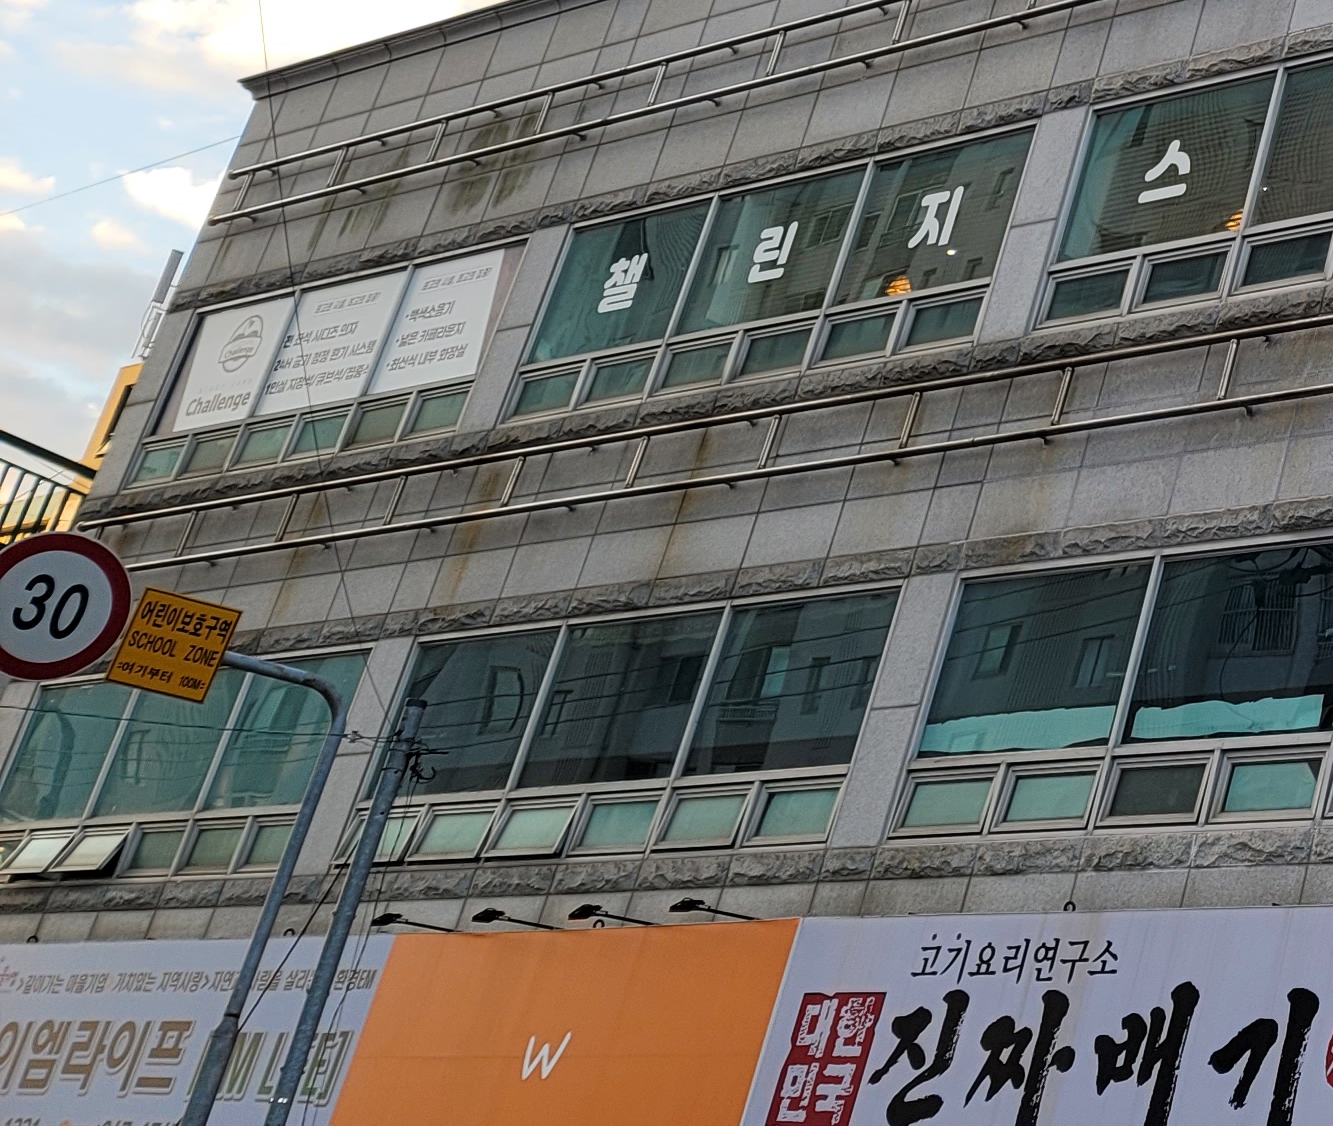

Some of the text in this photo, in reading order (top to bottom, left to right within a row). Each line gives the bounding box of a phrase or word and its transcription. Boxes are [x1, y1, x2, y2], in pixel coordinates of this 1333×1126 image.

[185, 391, 251, 417] Challenge
[12, 573, 90, 640] 30
[140, 600, 233, 645] 어린이보호구역
[128, 630, 220, 668] SCHOOL ZONE
[112, 972, 157, 993] 가치있는
[910, 935, 1119, 984] 고기요리연구소
[0, 1020, 196, 1097] 이엠라이프
[521, 1030, 573, 1081] W
[867, 980, 1321, 1126] 진짜배기
